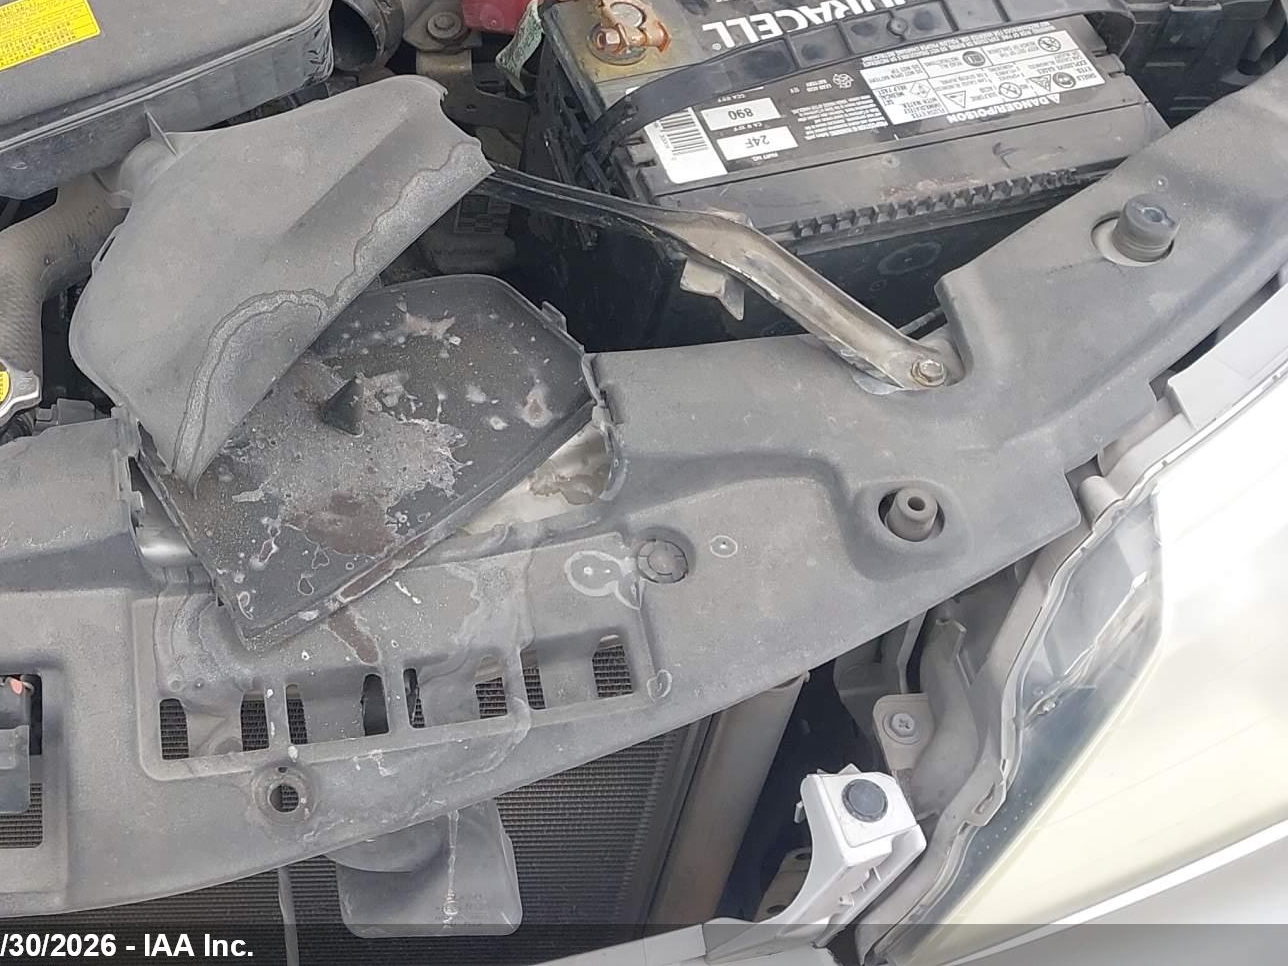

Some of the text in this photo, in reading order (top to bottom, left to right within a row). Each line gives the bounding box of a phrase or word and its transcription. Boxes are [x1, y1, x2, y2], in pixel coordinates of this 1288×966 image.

[727, 108, 754, 120] 890
[946, 96, 1050, 123] DANGER/POISON
[744, 135, 770, 149] 24F
